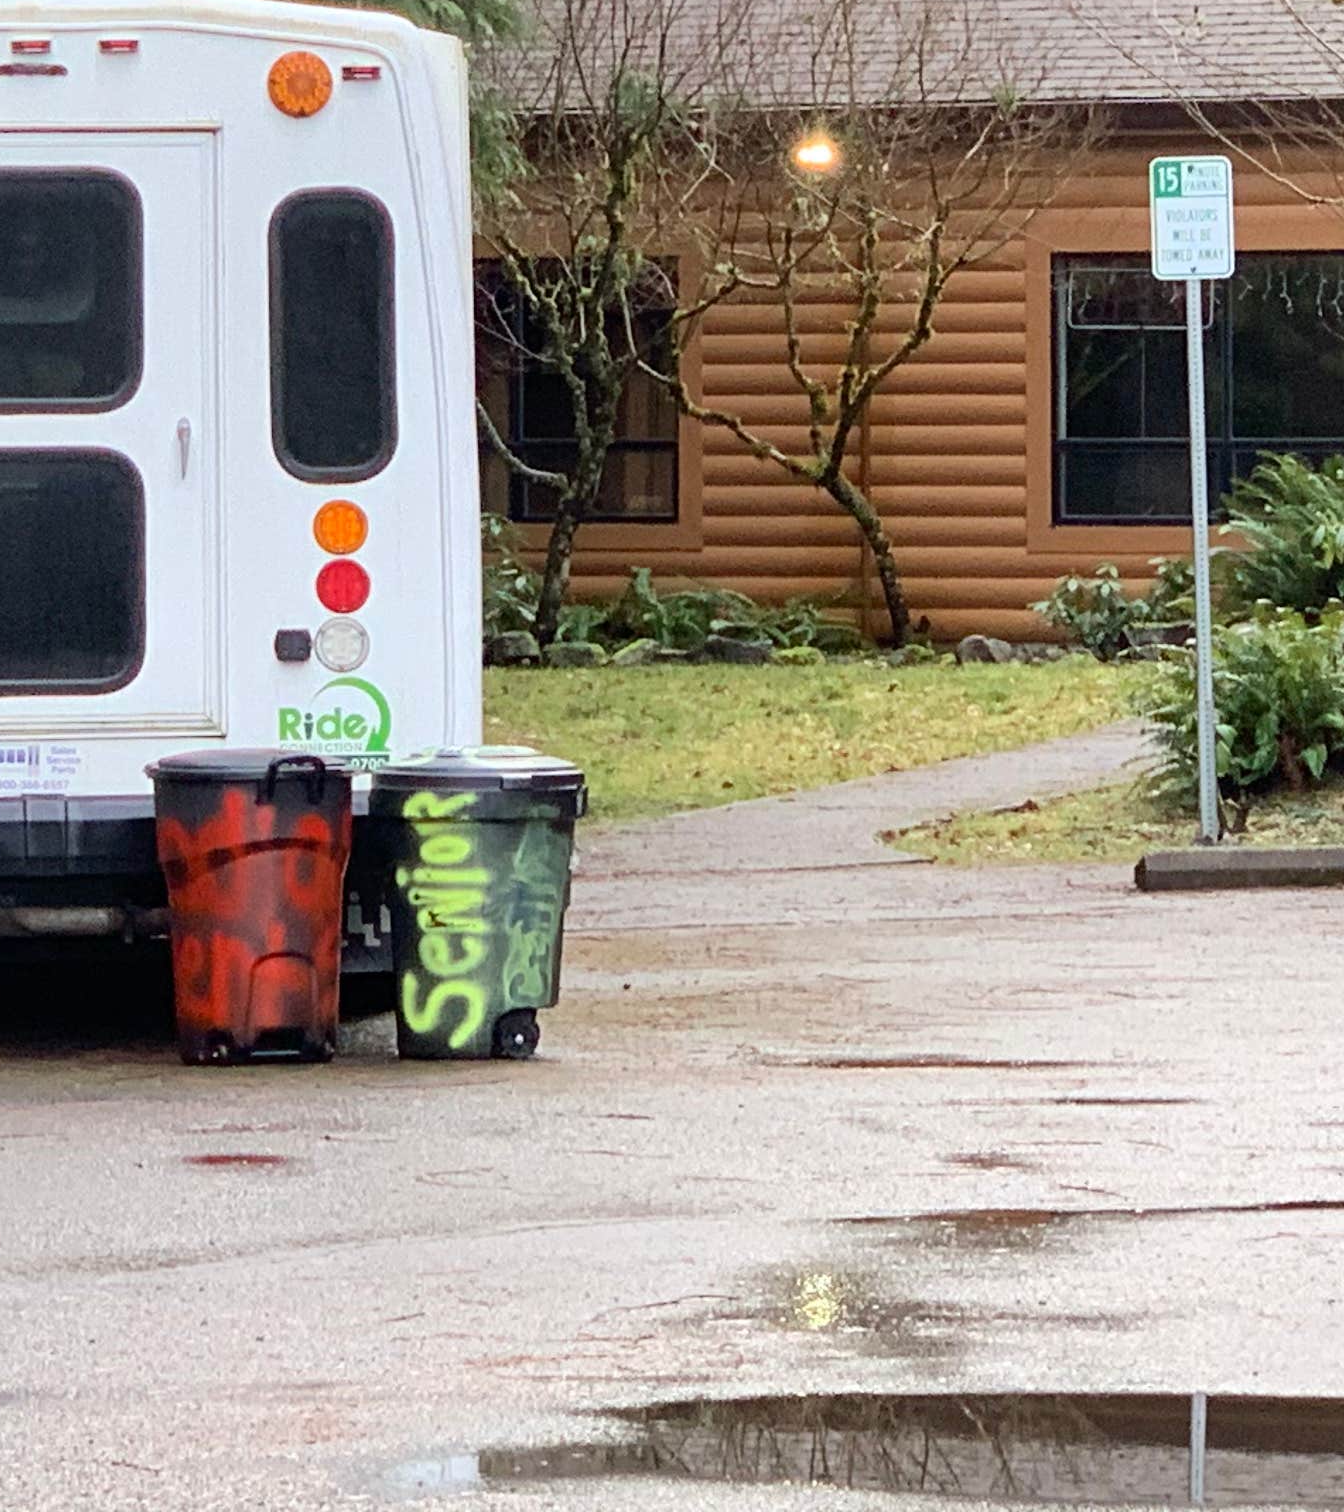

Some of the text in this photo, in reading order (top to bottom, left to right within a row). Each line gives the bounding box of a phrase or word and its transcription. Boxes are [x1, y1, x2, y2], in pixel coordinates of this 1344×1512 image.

[1158, 166, 1179, 193] 15
[1166, 208, 1218, 222] VIOLATORS
[1172, 229, 1195, 243] WILL
[1161, 248, 1224, 263] TOWED AWAY
[278, 706, 369, 741] Ride
[280, 742, 364, 754] CONNECTION
